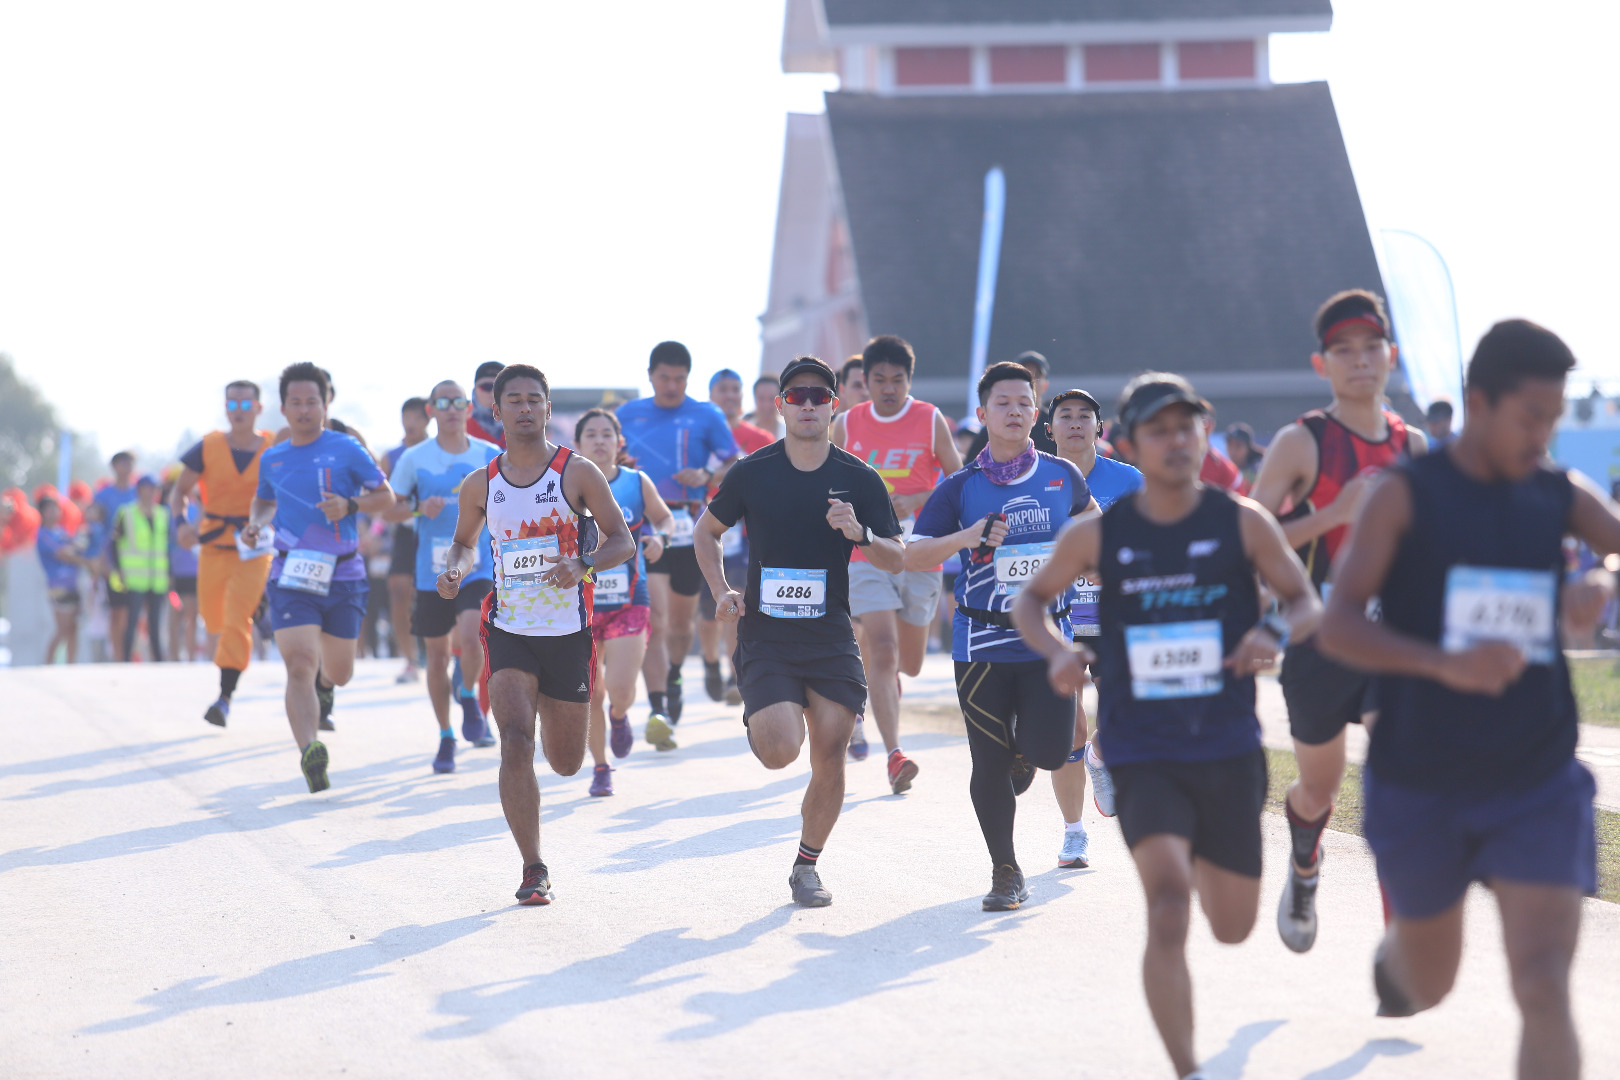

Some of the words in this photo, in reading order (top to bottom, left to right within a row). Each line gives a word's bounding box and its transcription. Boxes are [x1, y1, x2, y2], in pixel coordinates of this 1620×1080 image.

[867, 449, 924, 469] LET
[1005, 507, 1050, 527] RKPOINT
[1032, 523, 1051, 531] CLUB
[293, 562, 324, 578] 6193
[513, 554, 544, 570] 6291
[776, 586, 812, 599] 6286
[811, 608, 819, 617] 16
